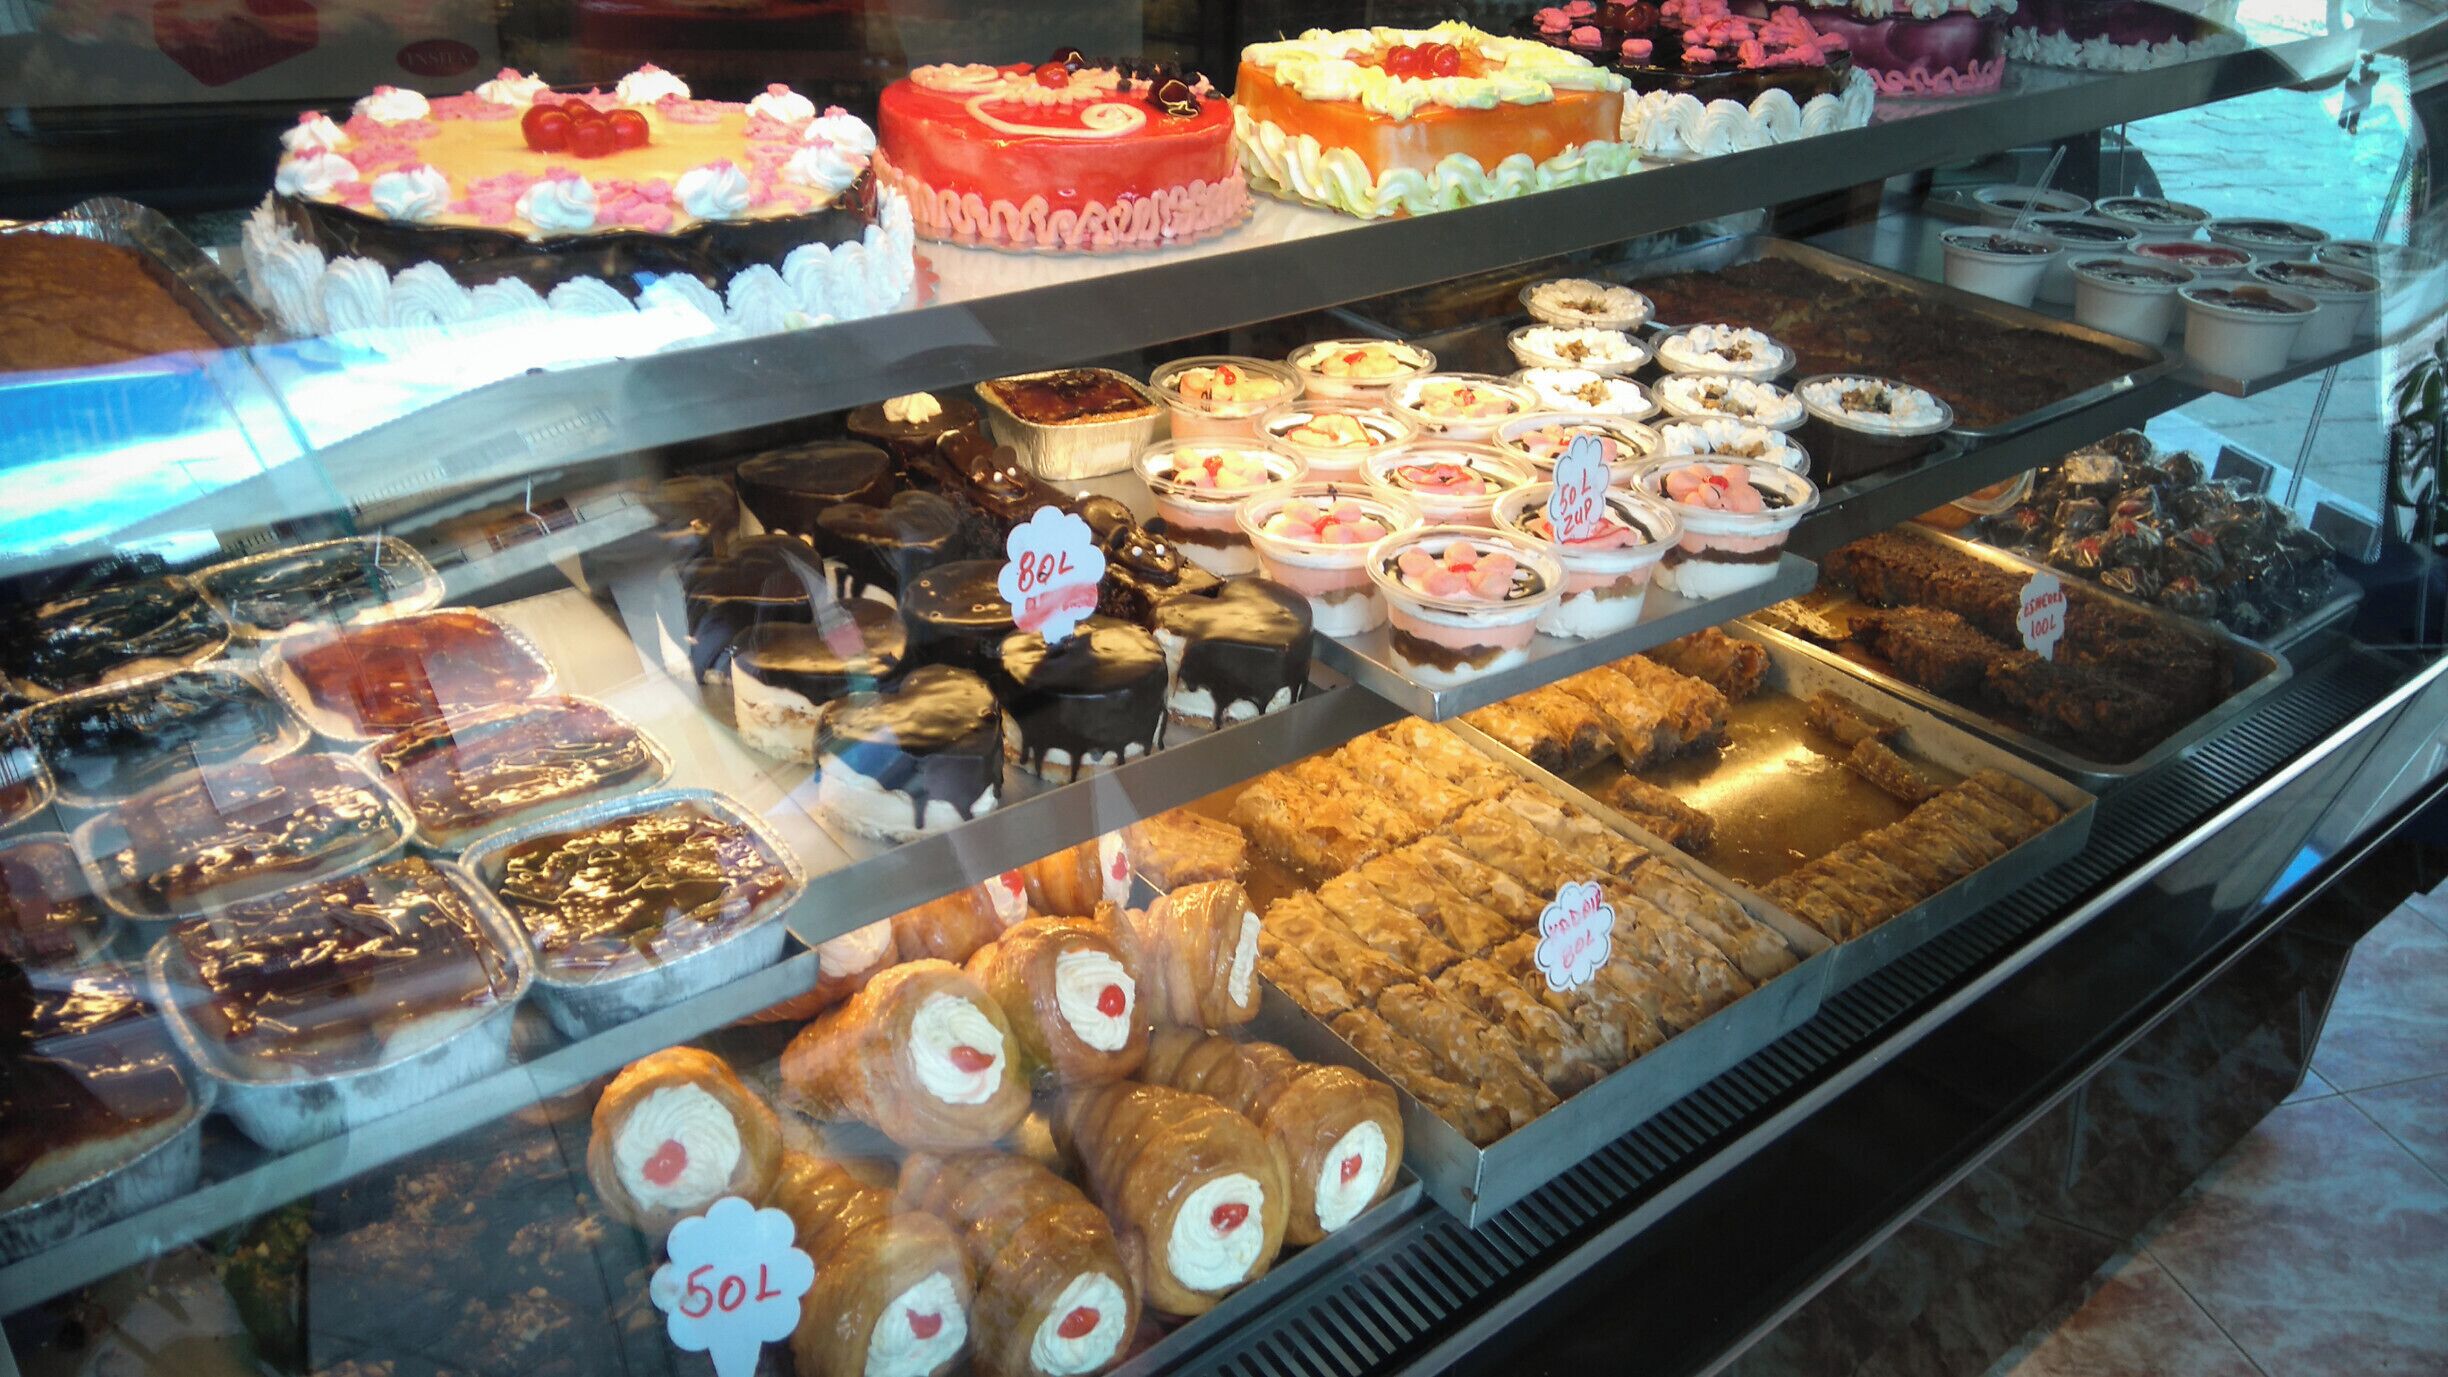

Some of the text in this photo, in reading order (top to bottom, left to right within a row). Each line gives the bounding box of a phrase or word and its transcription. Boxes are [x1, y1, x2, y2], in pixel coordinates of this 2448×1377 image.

[1018, 550, 1073, 592] 80L
[2031, 614, 2057, 639] 100L
[680, 1263, 782, 1318] 50L
